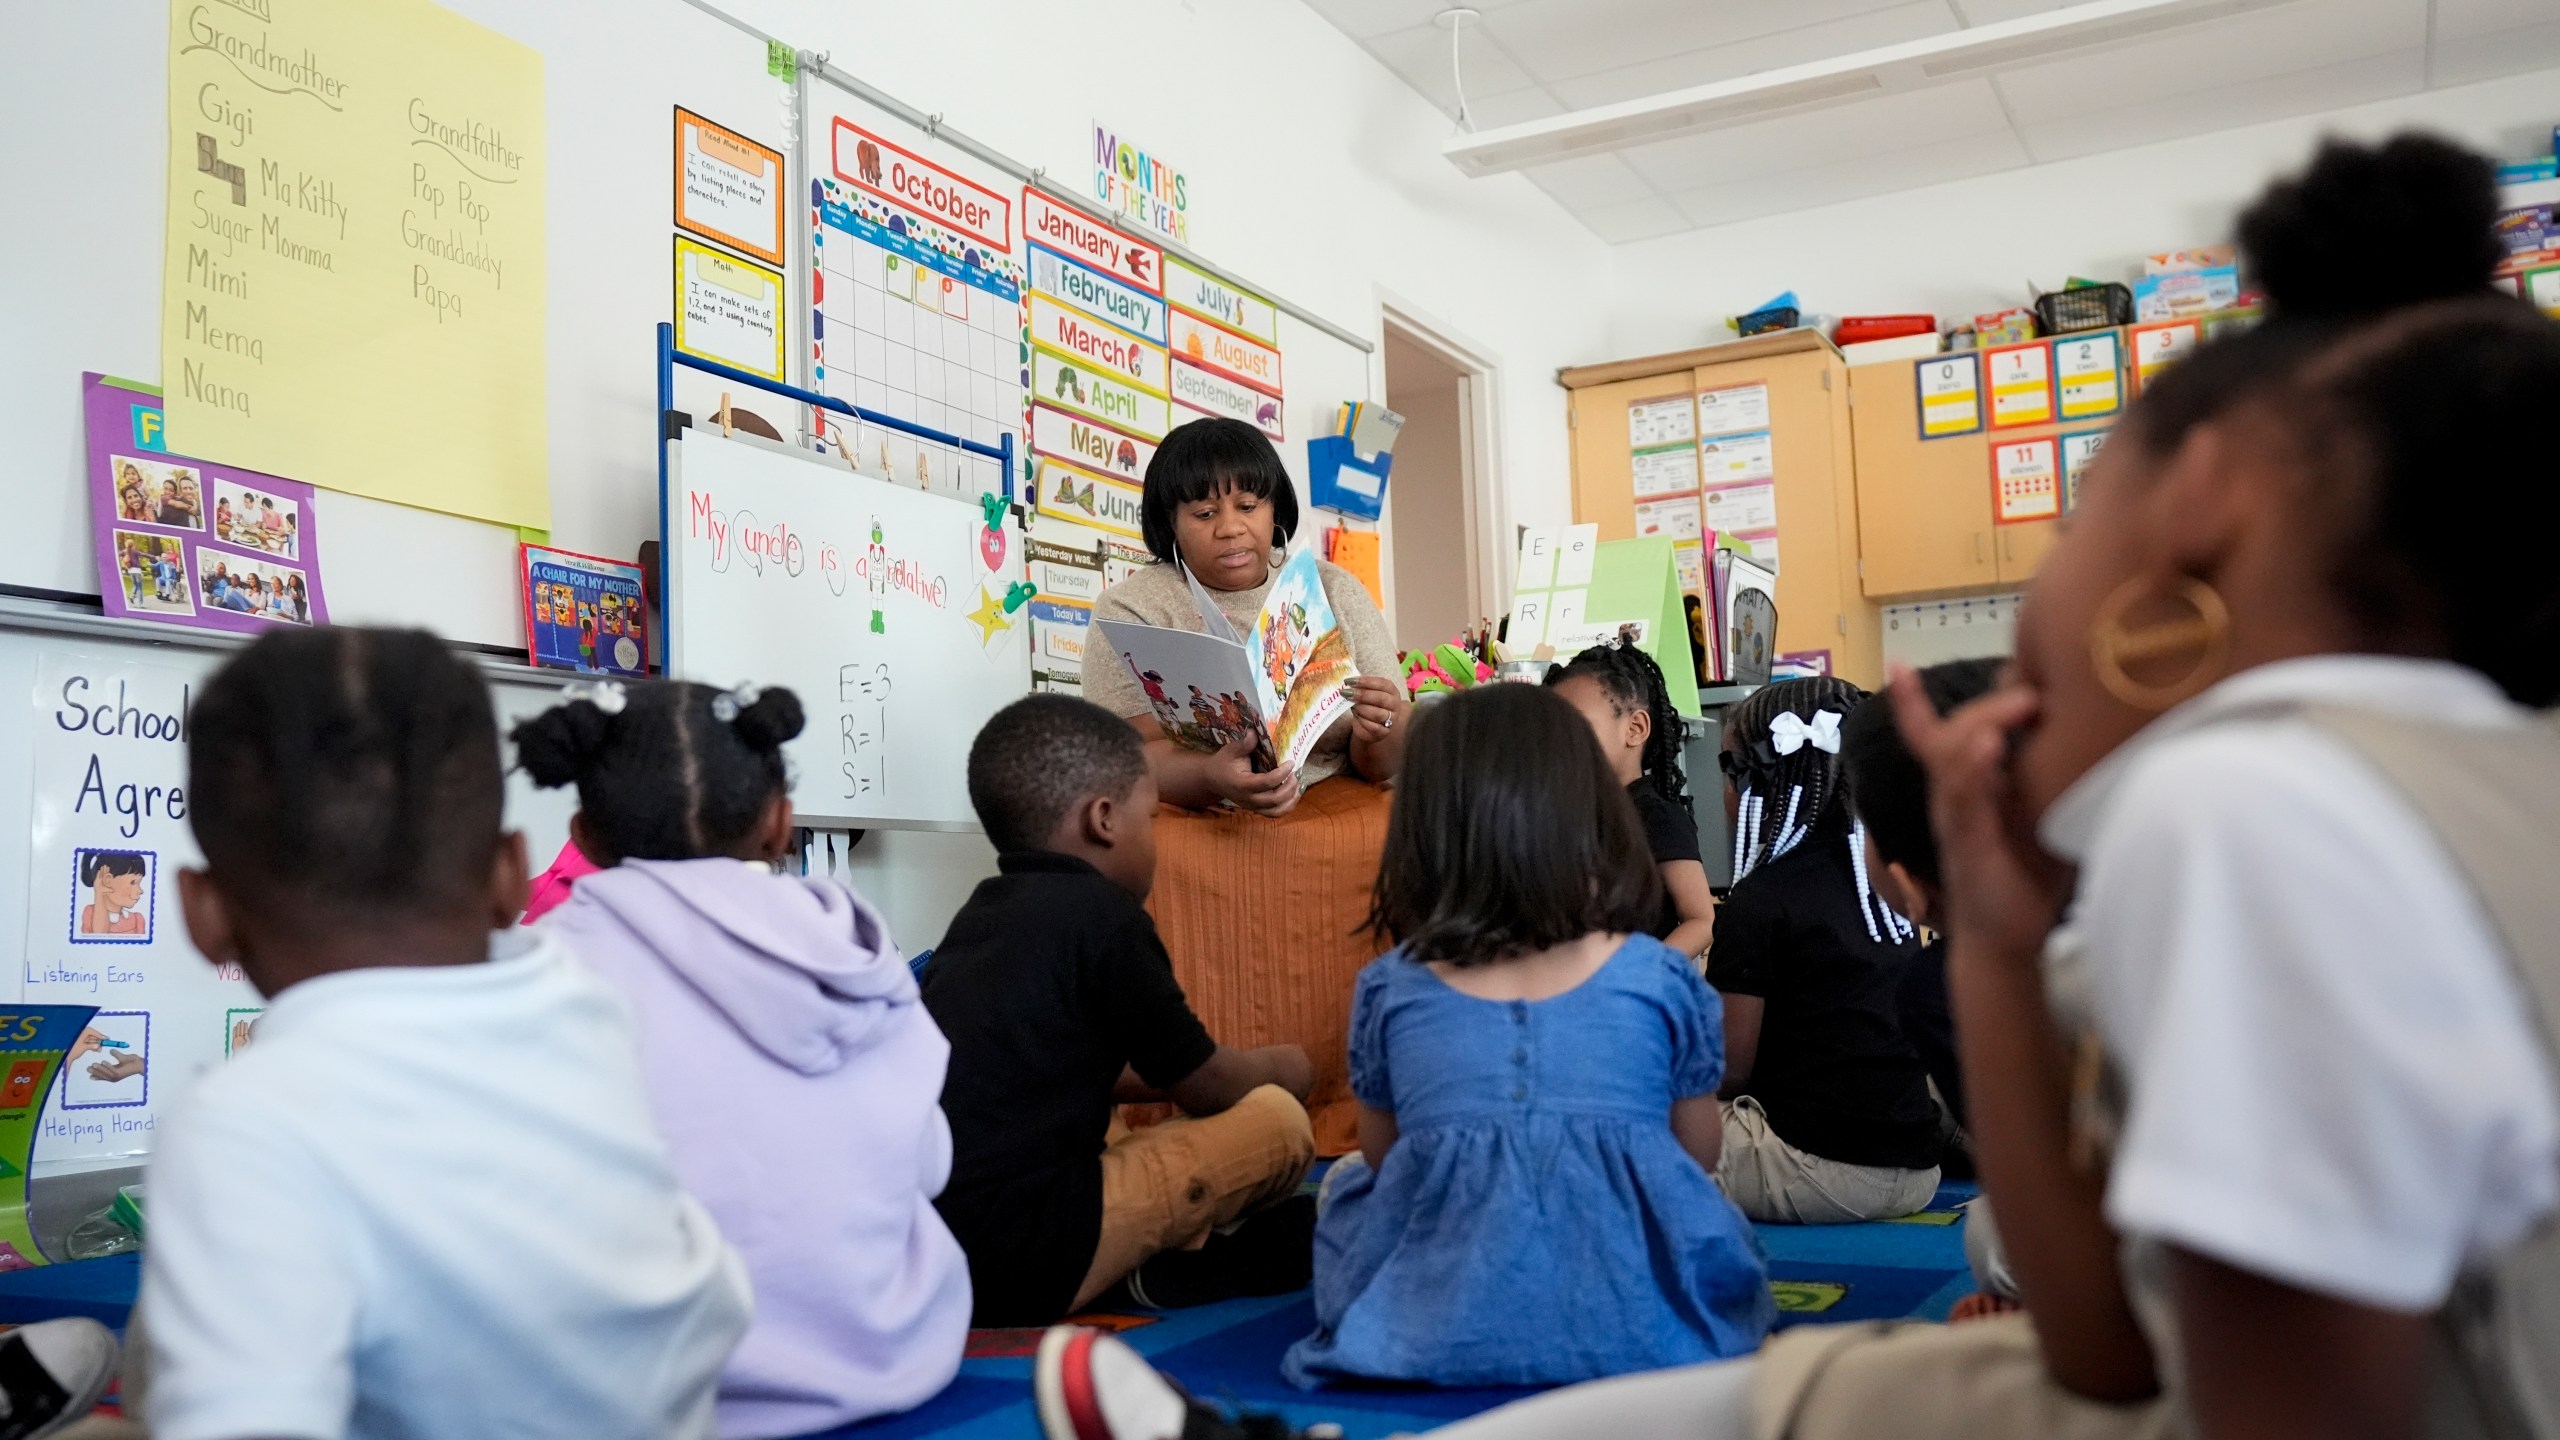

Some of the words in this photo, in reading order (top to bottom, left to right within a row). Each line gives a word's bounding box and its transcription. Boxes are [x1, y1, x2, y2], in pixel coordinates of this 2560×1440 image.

[189, 5, 349, 98] Grandmother
[199, 83, 252, 147] Gigi
[409, 98, 524, 170] Grandfather
[704, 130, 721, 143] Read
[688, 152, 696, 165] I
[702, 160, 716, 172] can
[749, 181, 765, 197] story
[688, 167, 696, 182] by
[702, 174, 724, 193] listing
[726, 185, 746, 200] places
[750, 196, 762, 206] and
[1096, 127, 1187, 212] MONTHS
[261, 157, 290, 207] Ma
[299, 172, 347, 240] Kitty
[413, 163, 444, 219] Pop
[459, 181, 489, 235] Pop
[826, 203, 847, 220] Sunday
[892, 162, 991, 230] October
[1097, 171, 1114, 203] OF
[1121, 182, 1147, 222] THE
[1152, 199, 1187, 244] YEAR
[192, 190, 253, 257] Sugar
[262, 213, 335, 273] Momma
[855, 217, 878, 233] Monday
[886, 230, 908, 247] Tuesday
[1038, 206, 1120, 269] January
[402, 209, 501, 290] Granddaddy
[714, 259, 733, 274] Math
[187, 243, 247, 299] Mimi
[971, 267, 987, 280] Friday
[414, 265, 461, 323] Papa
[691, 282, 699, 295] I
[704, 289, 717, 300] can
[721, 297, 741, 309] make
[744, 305, 759, 316] sets
[763, 310, 771, 320] of
[1061, 263, 1151, 331] February
[1197, 281, 1232, 319] July
[186, 300, 263, 365] Mema
[703, 303, 715, 313] and
[719, 306, 723, 316] 3
[726, 313, 745, 328] using
[747, 318, 772, 337] counting
[1058, 316, 1125, 369] March
[1213, 335, 1269, 378] August
[2080, 343, 2092, 360] 2
[2160, 331, 2172, 348] 3
[1941, 364, 1953, 379] 0
[2014, 354, 2022, 369] 1
[184, 357, 250, 418] Nana
[1091, 381, 1137, 421] April
[1175, 368, 1252, 414] September
[1070, 422, 1115, 467] May
[2016, 446, 2033, 463] 11
[1100, 490, 1143, 519] June
[691, 490, 726, 560] My
[744, 523, 798, 563] uncle
[820, 541, 837, 571] is
[856, 557, 867, 579] a
[1533, 537, 1545, 556] E
[1572, 541, 1584, 552] e
[1035, 544, 1073, 564] Yesterday
[1117, 546, 1130, 559] The
[1132, 550, 1154, 563] seaso
[532, 564, 541, 577] A
[541, 566, 568, 582] CHAIR
[569, 571, 587, 587] FOR
[588, 575, 603, 590] MY
[604, 578, 640, 597] MOTHER
[1048, 569, 1090, 590] Thursday
[1052, 606, 1074, 622] Today
[1521, 603, 1537, 621] R
[1563, 607, 1571, 618] r
[1891, 619, 1898, 631] 0
[1940, 614, 1947, 626] 2
[1047, 667, 1081, 681] Tomorro
[56, 676, 189, 743] School
[27, 959, 97, 992] Listening
[107, 966, 144, 984] Ears
[45, 1116, 103, 1144] Helping
